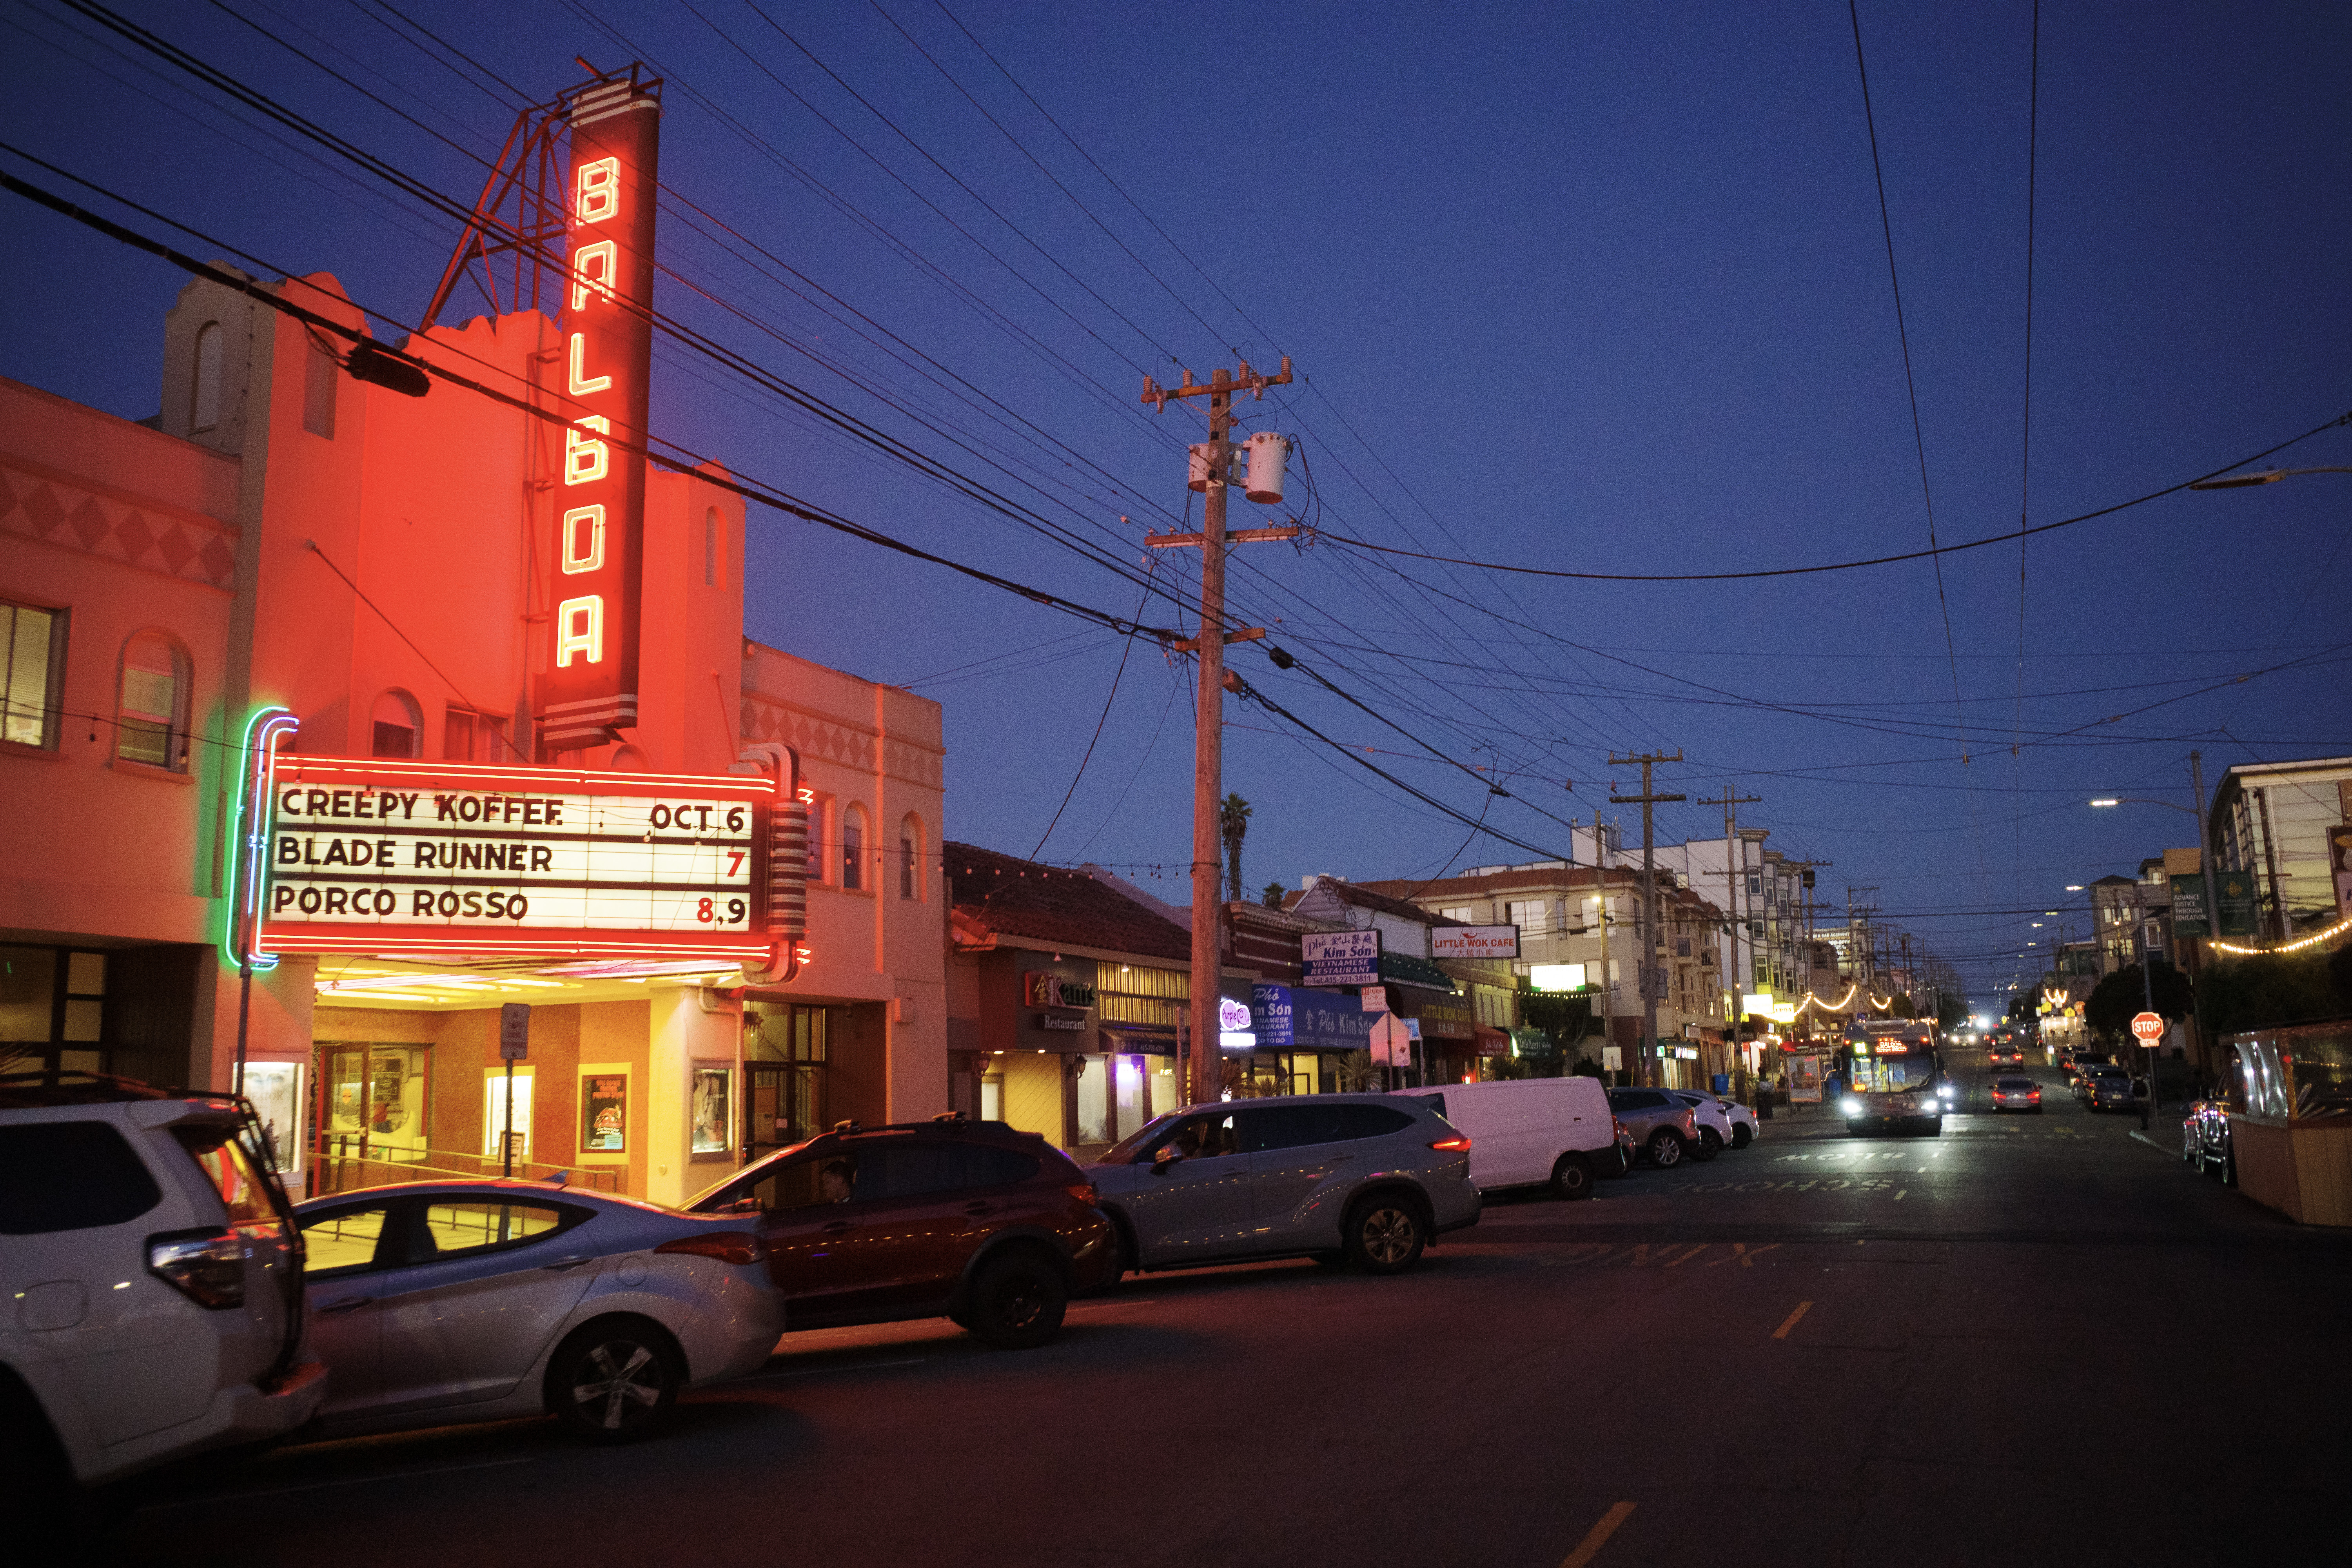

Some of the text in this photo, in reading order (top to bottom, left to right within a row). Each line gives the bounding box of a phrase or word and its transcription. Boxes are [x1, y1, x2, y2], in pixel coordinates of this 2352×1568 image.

[556, 156, 620, 668] BALBOA
[282, 788, 744, 833] CREEPY KOFFEE OCT 6
[279, 836, 746, 877] BLADE RUNNER 7
[275, 886, 396, 916] PORCO
[413, 889, 528, 920] ROSSO
[1434, 938, 1514, 948] LITTLE WOK CAFE
[1323, 947, 1346, 958] Kim
[1312, 959, 1369, 967] VIETNAMESE
[1311, 966, 1371, 975] RESTAURANT
[1045, 1015, 1085, 1030] Restaurant
[1222, 1009, 1237, 1023] Purple
[1339, 1013, 1357, 1035] Kim
[2134, 1021, 2160, 1033] STOP
